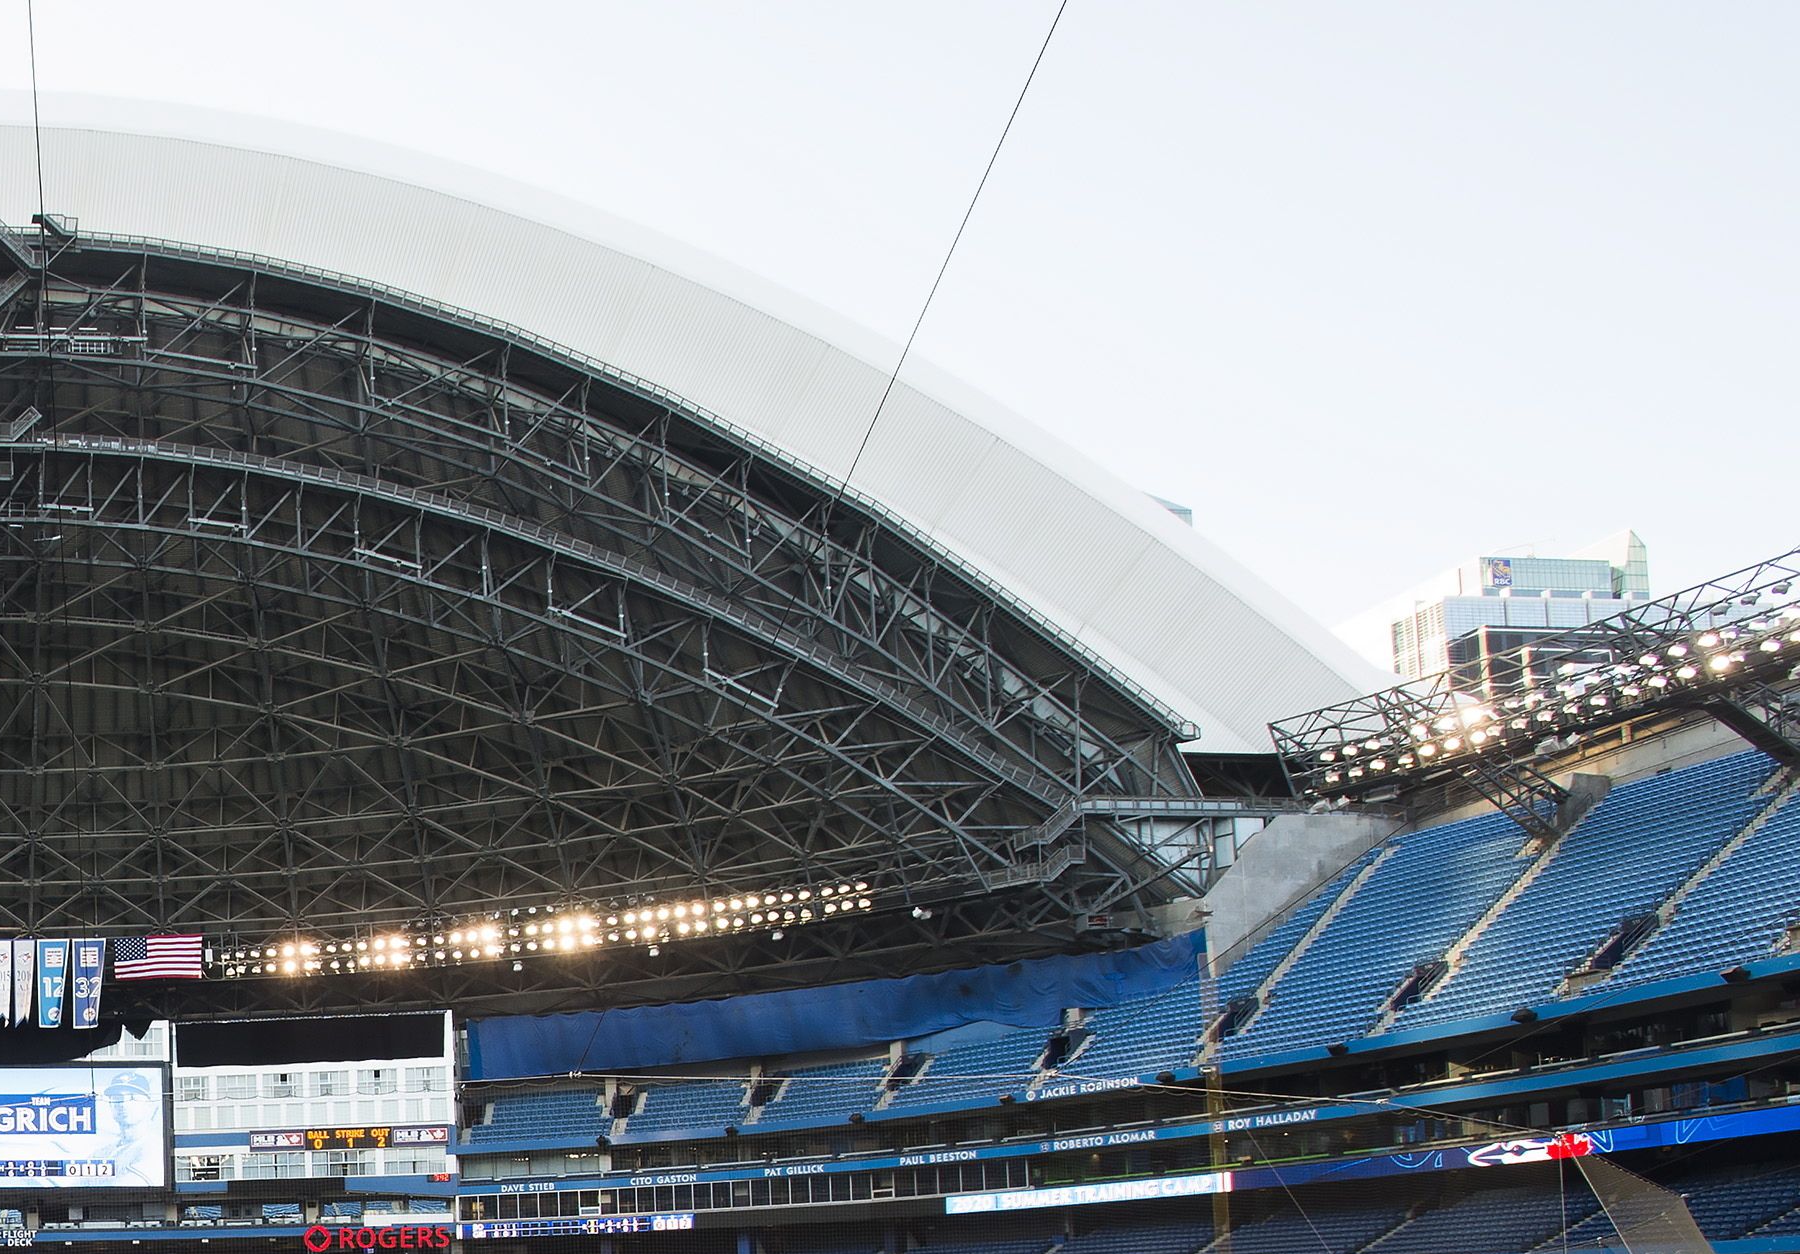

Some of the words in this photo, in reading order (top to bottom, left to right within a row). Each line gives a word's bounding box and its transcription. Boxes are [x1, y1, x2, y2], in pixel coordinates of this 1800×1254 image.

[42, 976, 64, 998] 12
[75, 976, 102, 998] 32
[1039, 1085, 1076, 1100] JACKIE
[1080, 1076, 1139, 1095] ROBINSON
[31, 1096, 51, 1106] TEAM
[1227, 1119, 1251, 1131] ROY
[1255, 1109, 1317, 1127] HALLADAY
[307, 1130, 330, 1140] BALL
[335, 1129, 366, 1139] STRIKE
[370, 1128, 390, 1138] OUT
[1053, 1136, 1103, 1151] ROBERTO
[1107, 1129, 1156, 1146] ALOMAR
[313, 1140, 323, 1150] 0
[347, 1138, 354, 1148] 1
[377, 1138, 386, 1148] 2
[900, 1154, 925, 1167] PAUL
[929, 1150, 977, 1165] BEESTON
[68, 1165, 77, 1176] 0
[102, 1165, 108, 1175] 2
[764, 1166, 783, 1177] PAT
[786, 1164, 825, 1176] GILLICK
[629, 1176, 652, 1187] CITO
[656, 1173, 698, 1185] GASTON
[501, 1183, 526, 1194] DAVE
[528, 1181, 556, 1192] STIEB
[1074, 1182, 1159, 1203] TRAINING
[1160, 1177, 1212, 1196] CAMP
[3, 1230, 38, 1239] FLIGHT
[338, 1226, 450, 1249] ROGERS
[7, 1238, 33, 1247] DECK
